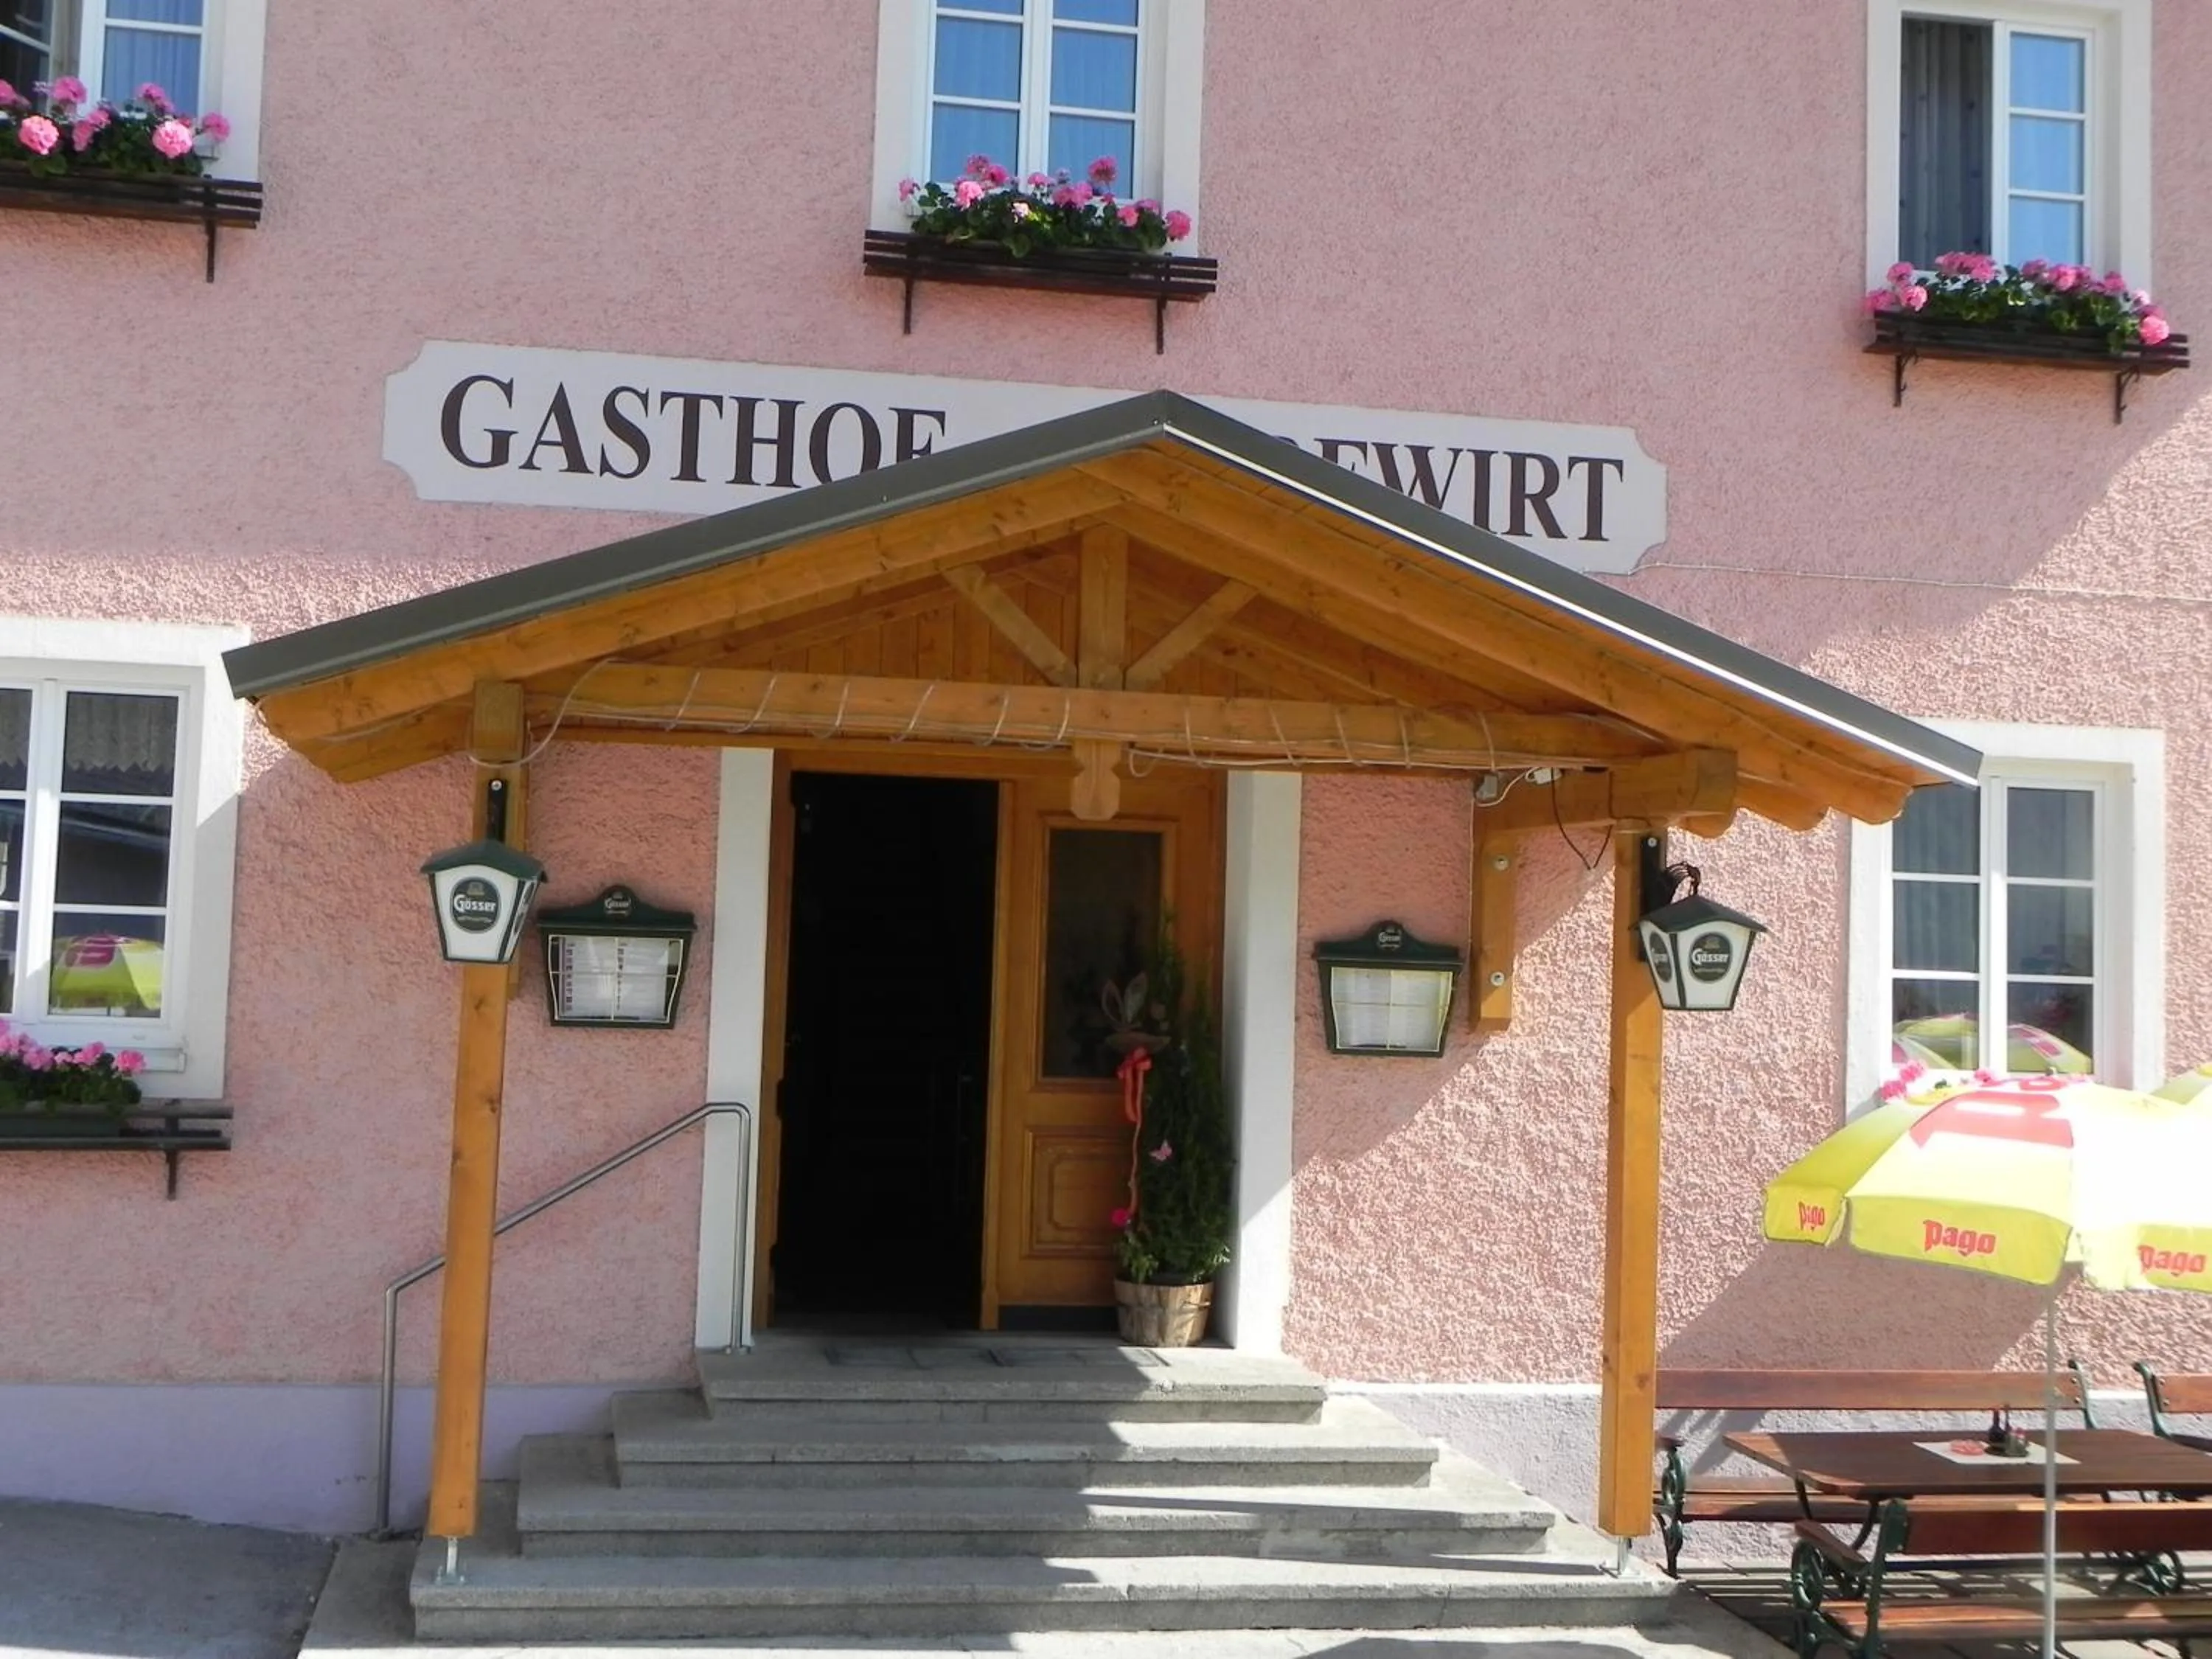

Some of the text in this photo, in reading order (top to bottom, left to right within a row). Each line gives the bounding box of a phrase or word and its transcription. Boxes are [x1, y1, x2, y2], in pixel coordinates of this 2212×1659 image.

[440, 374, 946, 490] GASTHOF
[453, 894, 496, 913] Gösser
[1691, 947, 1729, 965] Gösser
[1923, 1220, 1996, 1257] pago
[2138, 1244, 2207, 1277] pago
